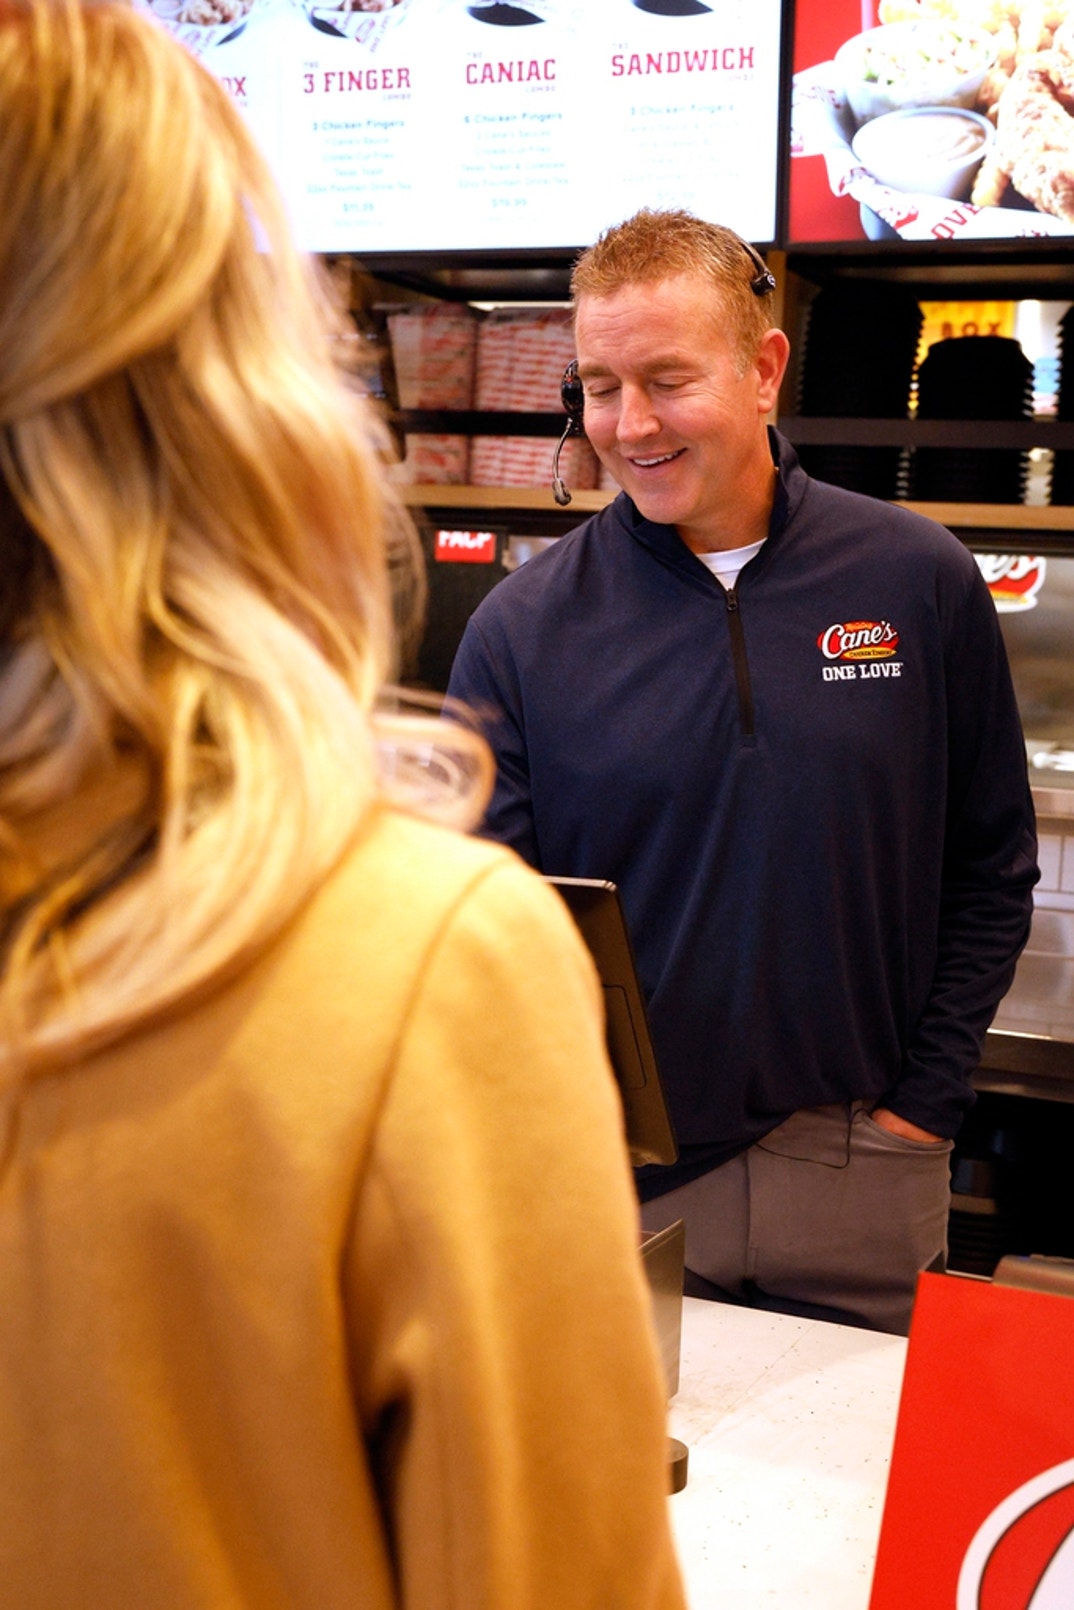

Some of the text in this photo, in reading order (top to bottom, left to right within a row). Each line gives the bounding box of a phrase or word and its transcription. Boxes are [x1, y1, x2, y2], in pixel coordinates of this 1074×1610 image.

[466, 59, 557, 85] CANIAC
[612, 47, 754, 76] SANDWICH
[221, 76, 247, 97] OX
[303, 67, 412, 94] 3 FINGER
[321, 120, 362, 131] Chicken
[366, 118, 405, 130] Fingers
[474, 114, 517, 124] Chicken
[521, 112, 563, 123] Fingers
[930, 203, 984, 240] OVE
[821, 620, 898, 660] Cane's
[822, 662, 902, 681] ONE LOVE
